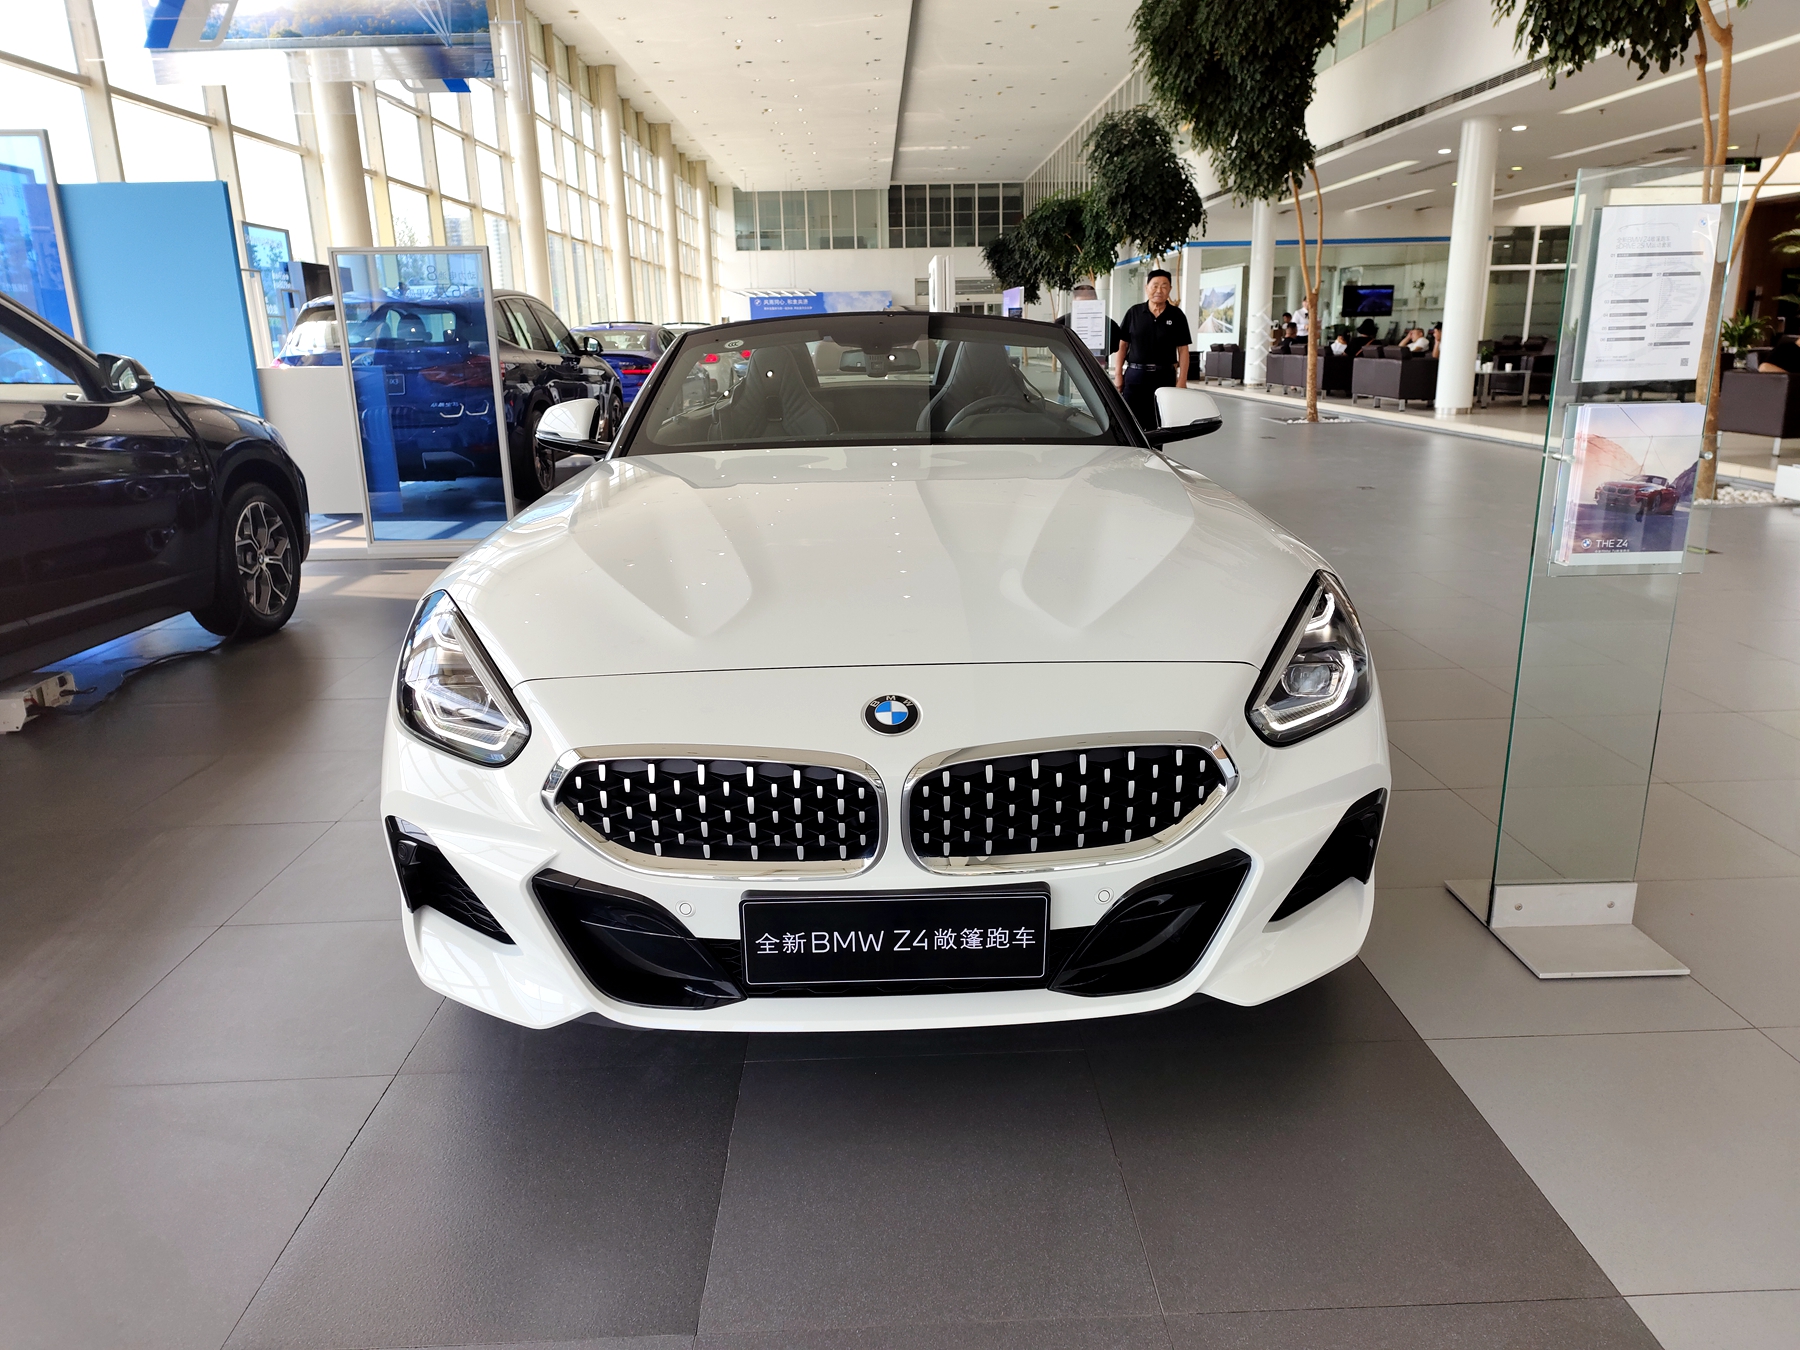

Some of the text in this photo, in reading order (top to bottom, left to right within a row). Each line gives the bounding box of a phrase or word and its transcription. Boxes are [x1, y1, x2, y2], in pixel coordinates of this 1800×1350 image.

[1596, 538, 1628, 548] THE Z4
[870, 695, 913, 707] BMW
[755, 926, 1036, 954] 全新BMW Z4敞篷跑车
